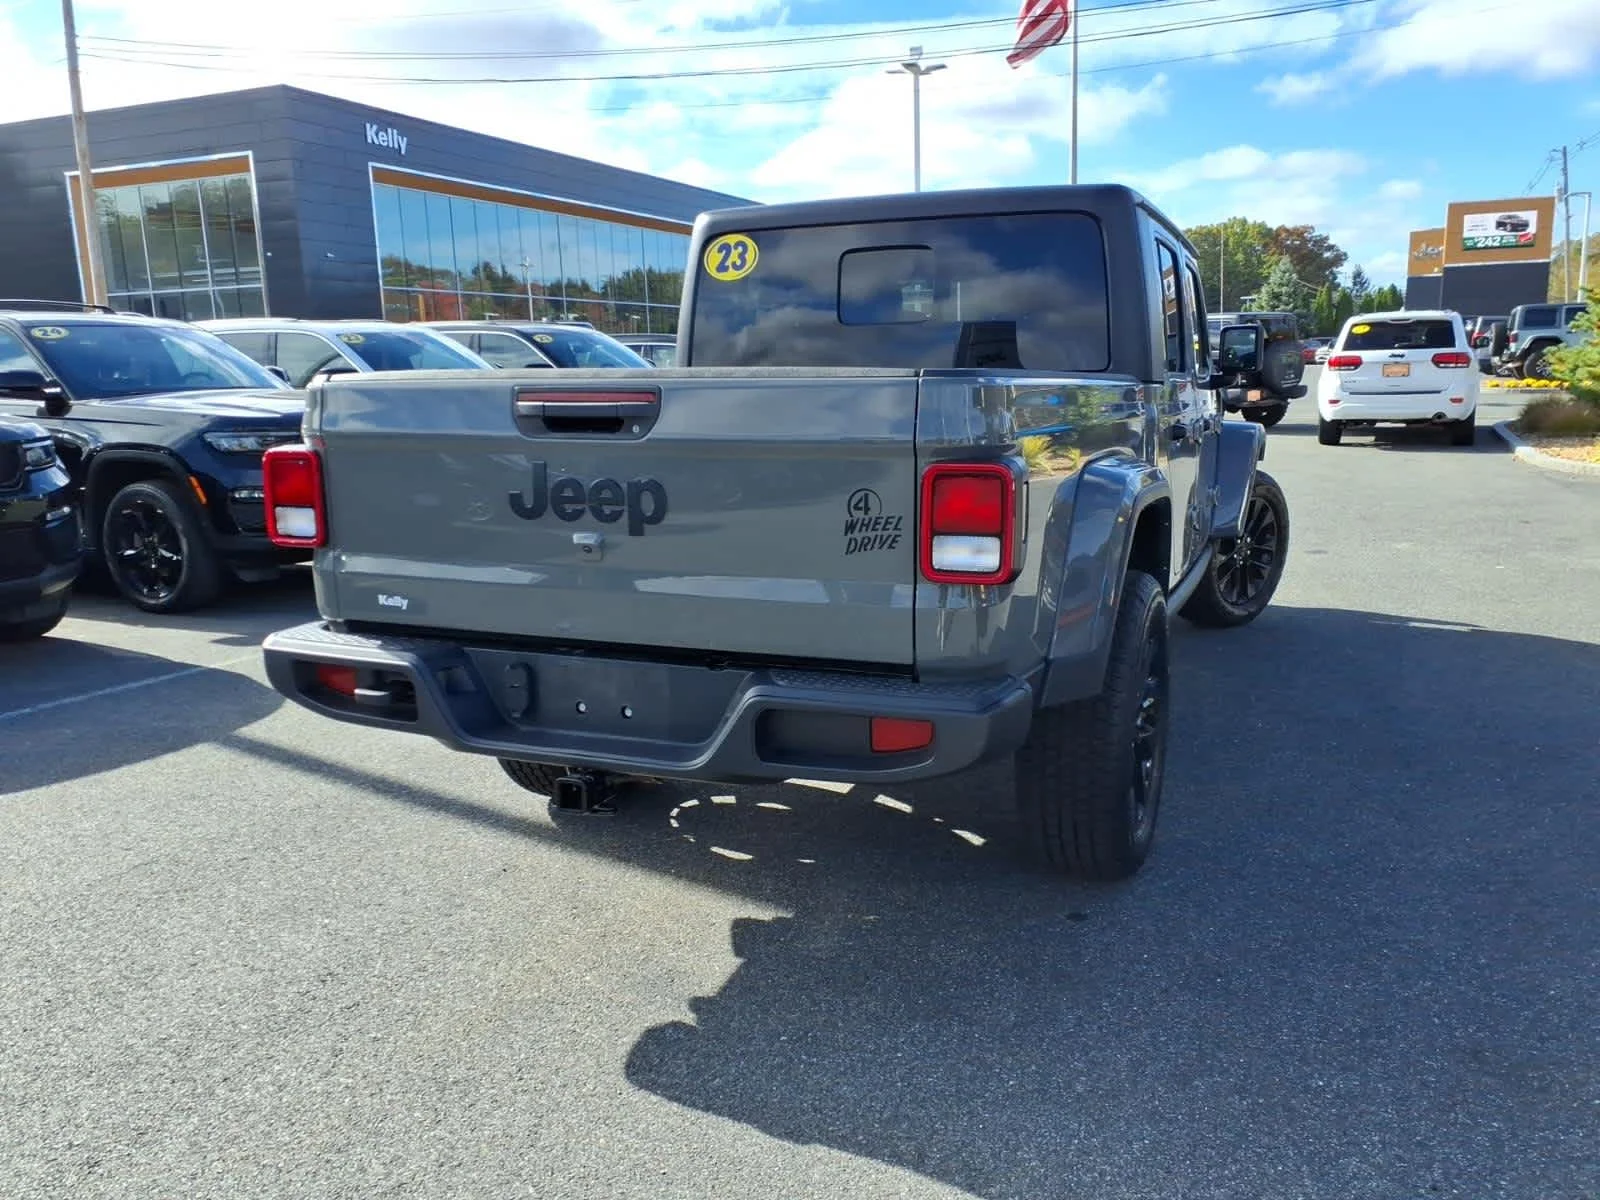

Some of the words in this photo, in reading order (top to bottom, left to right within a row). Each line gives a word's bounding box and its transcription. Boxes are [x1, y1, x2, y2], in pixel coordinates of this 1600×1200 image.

[365, 122, 408, 155] Kelly
[716, 241, 748, 273] 23
[508, 460, 668, 537] Jeep
[852, 492, 871, 516] 4
[843, 515, 903, 537] WHEEL
[844, 534, 902, 556] DRIVE
[377, 594, 409, 610] Kelly
